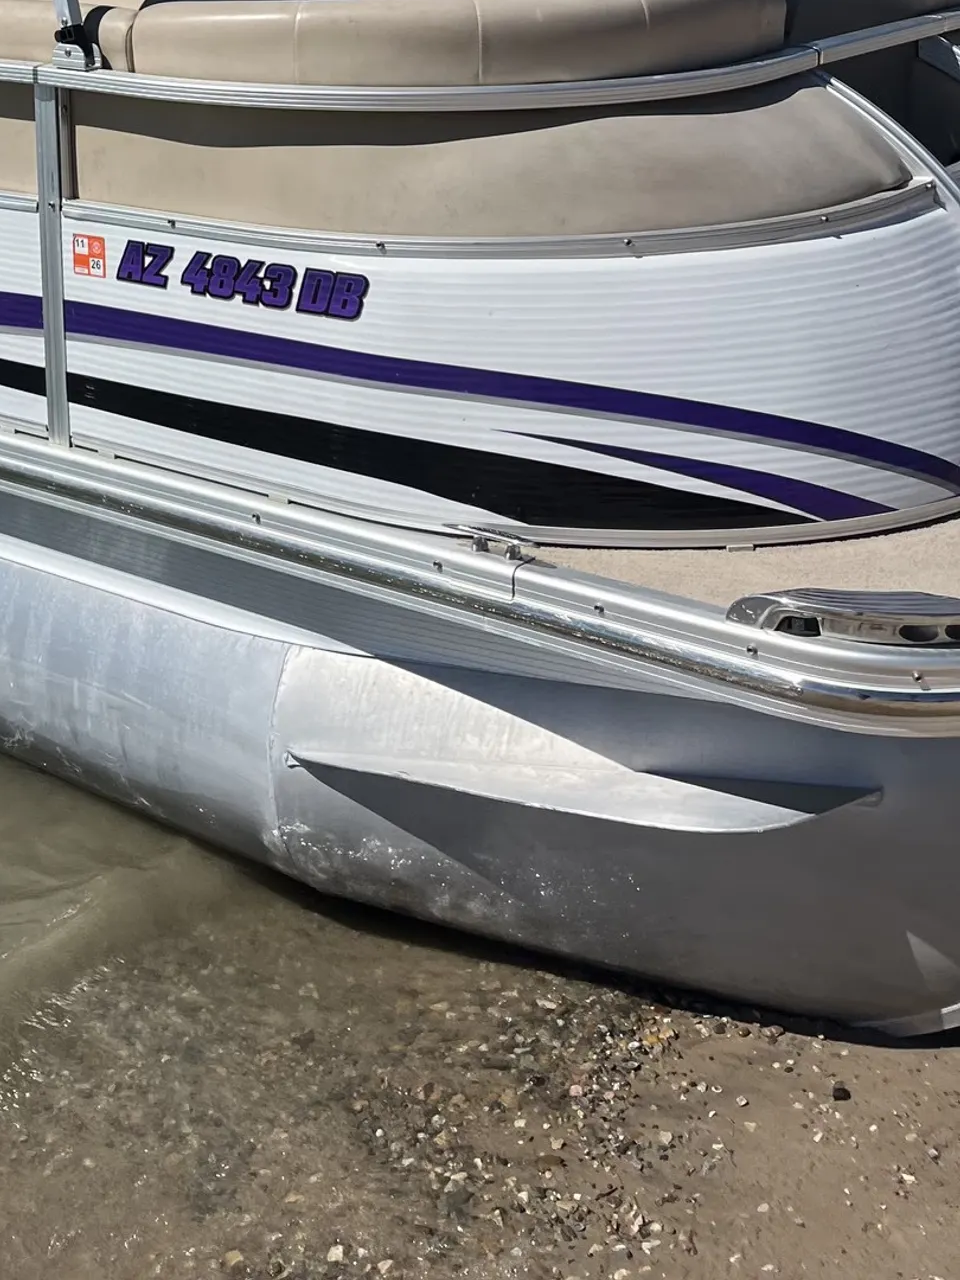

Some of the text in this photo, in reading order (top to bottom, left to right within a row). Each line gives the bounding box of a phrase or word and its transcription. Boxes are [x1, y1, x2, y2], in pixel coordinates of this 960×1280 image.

[75, 238, 85, 248] 11
[91, 259, 101, 270] 26
[116, 239, 370, 321] AZ 4843 DB
